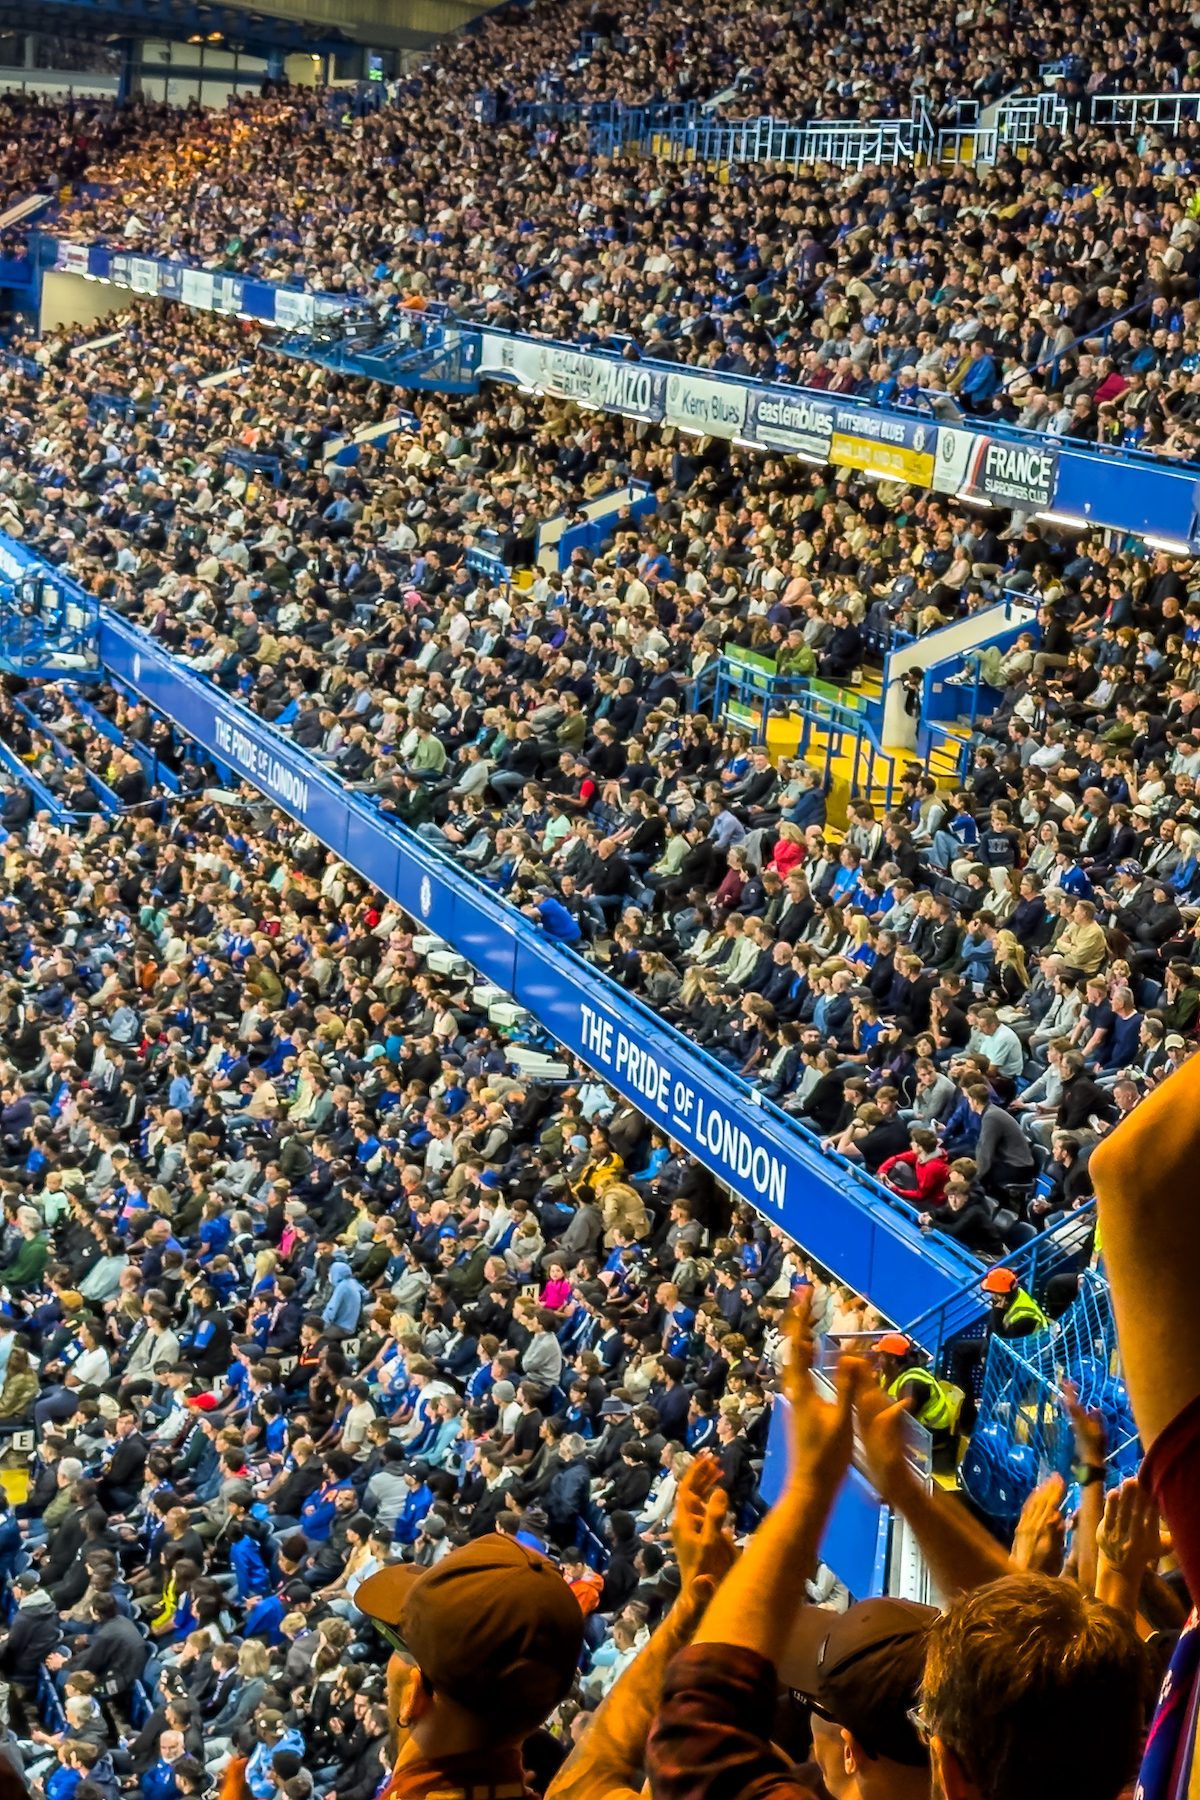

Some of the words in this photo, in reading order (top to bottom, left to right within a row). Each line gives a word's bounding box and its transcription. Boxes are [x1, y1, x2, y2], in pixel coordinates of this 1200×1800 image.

[681, 387, 709, 423] Kerry
[712, 395, 740, 424] Blues
[836, 412, 880, 437] PITTSBURGH
[881, 421, 906, 443] BLUES
[985, 446, 1053, 488] FRANCE
[985, 478, 1028, 500] SUPPORTERS
[1029, 488, 1048, 505] CLUB
[215, 716, 232, 753] THE
[231, 729, 258, 774] PRIDE
[258, 749, 269, 771] OF
[267, 757, 308, 814] LONDON
[580, 1003, 614, 1065] THE
[615, 1032, 671, 1114] PRIDE
[674, 1081, 695, 1117] OF
[695, 1099, 787, 1210] LONDON
[524, 1287, 535, 1298] N
[346, 1342, 356, 1355] K
[19, 1434, 28, 1448] E
